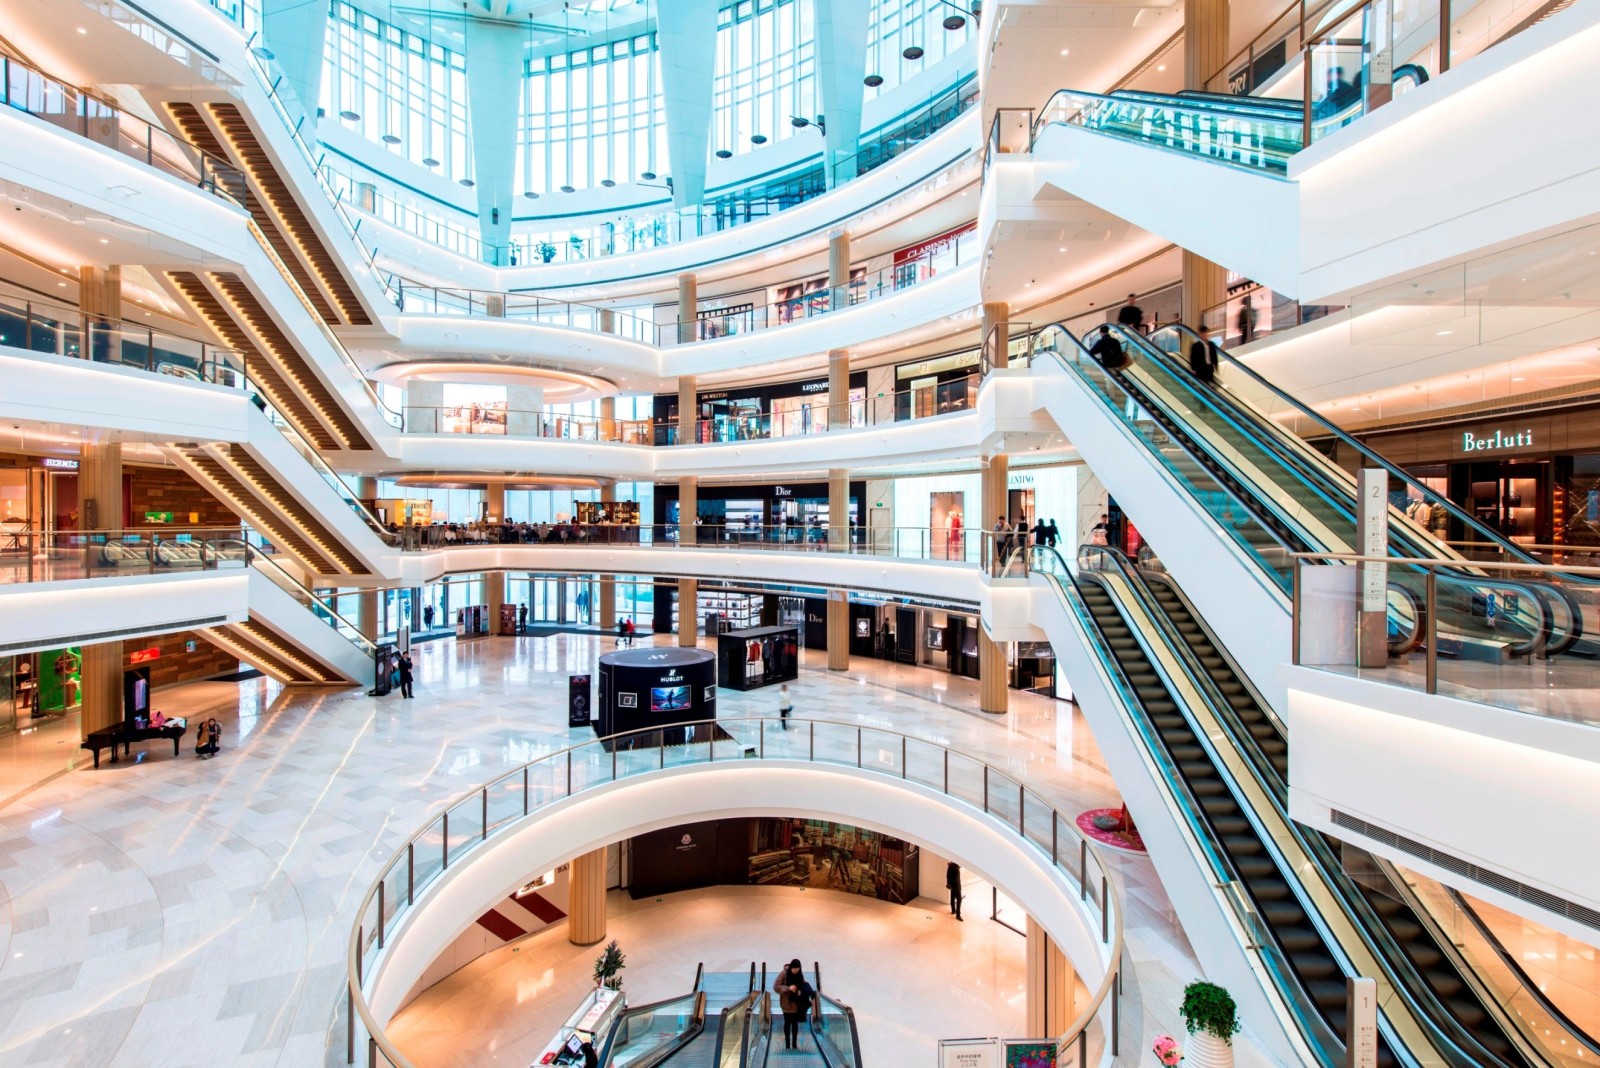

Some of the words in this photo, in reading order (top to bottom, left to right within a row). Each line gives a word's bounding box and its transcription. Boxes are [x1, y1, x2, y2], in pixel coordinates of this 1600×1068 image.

[1463, 429, 1533, 452] Berluti
[775, 486, 791, 496] Dior
[1372, 485, 1380, 498] 2
[808, 613, 823, 623] Dior
[660, 675, 684, 683] HUBLOT
[1363, 996, 1368, 1009] 1
